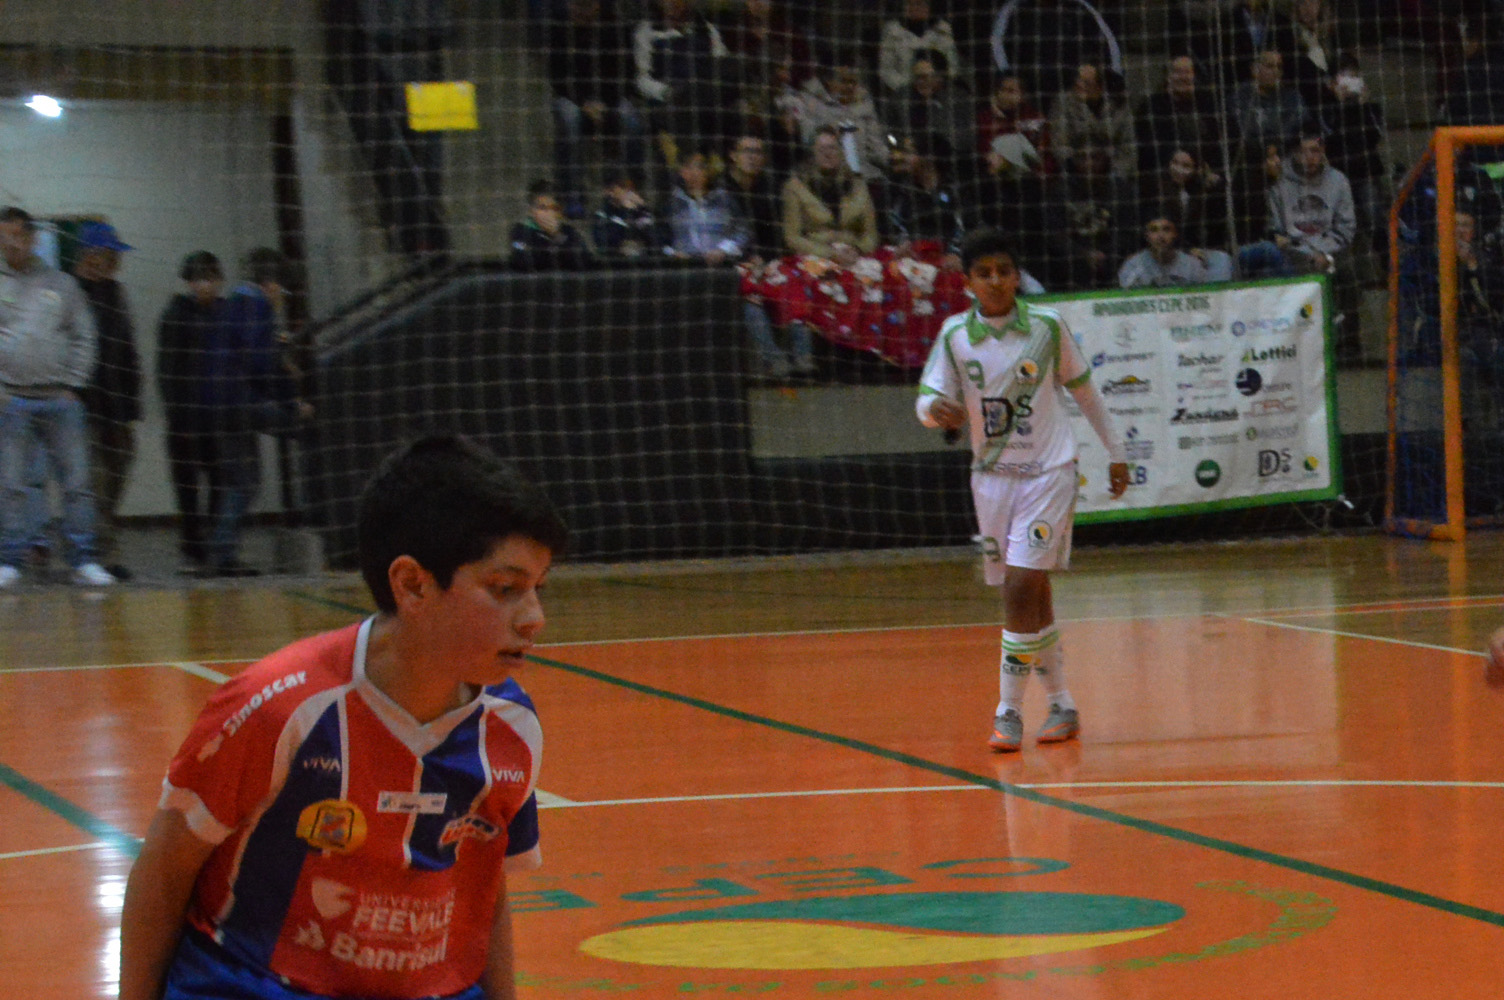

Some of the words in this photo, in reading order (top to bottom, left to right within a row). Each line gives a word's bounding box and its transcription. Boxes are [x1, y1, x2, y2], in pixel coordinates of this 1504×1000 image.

[965, 360, 985, 390] 9
[223, 668, 307, 737] Sinoscar
[353, 901, 455, 934] FEEVALE
[331, 929, 450, 971] Banrisul
